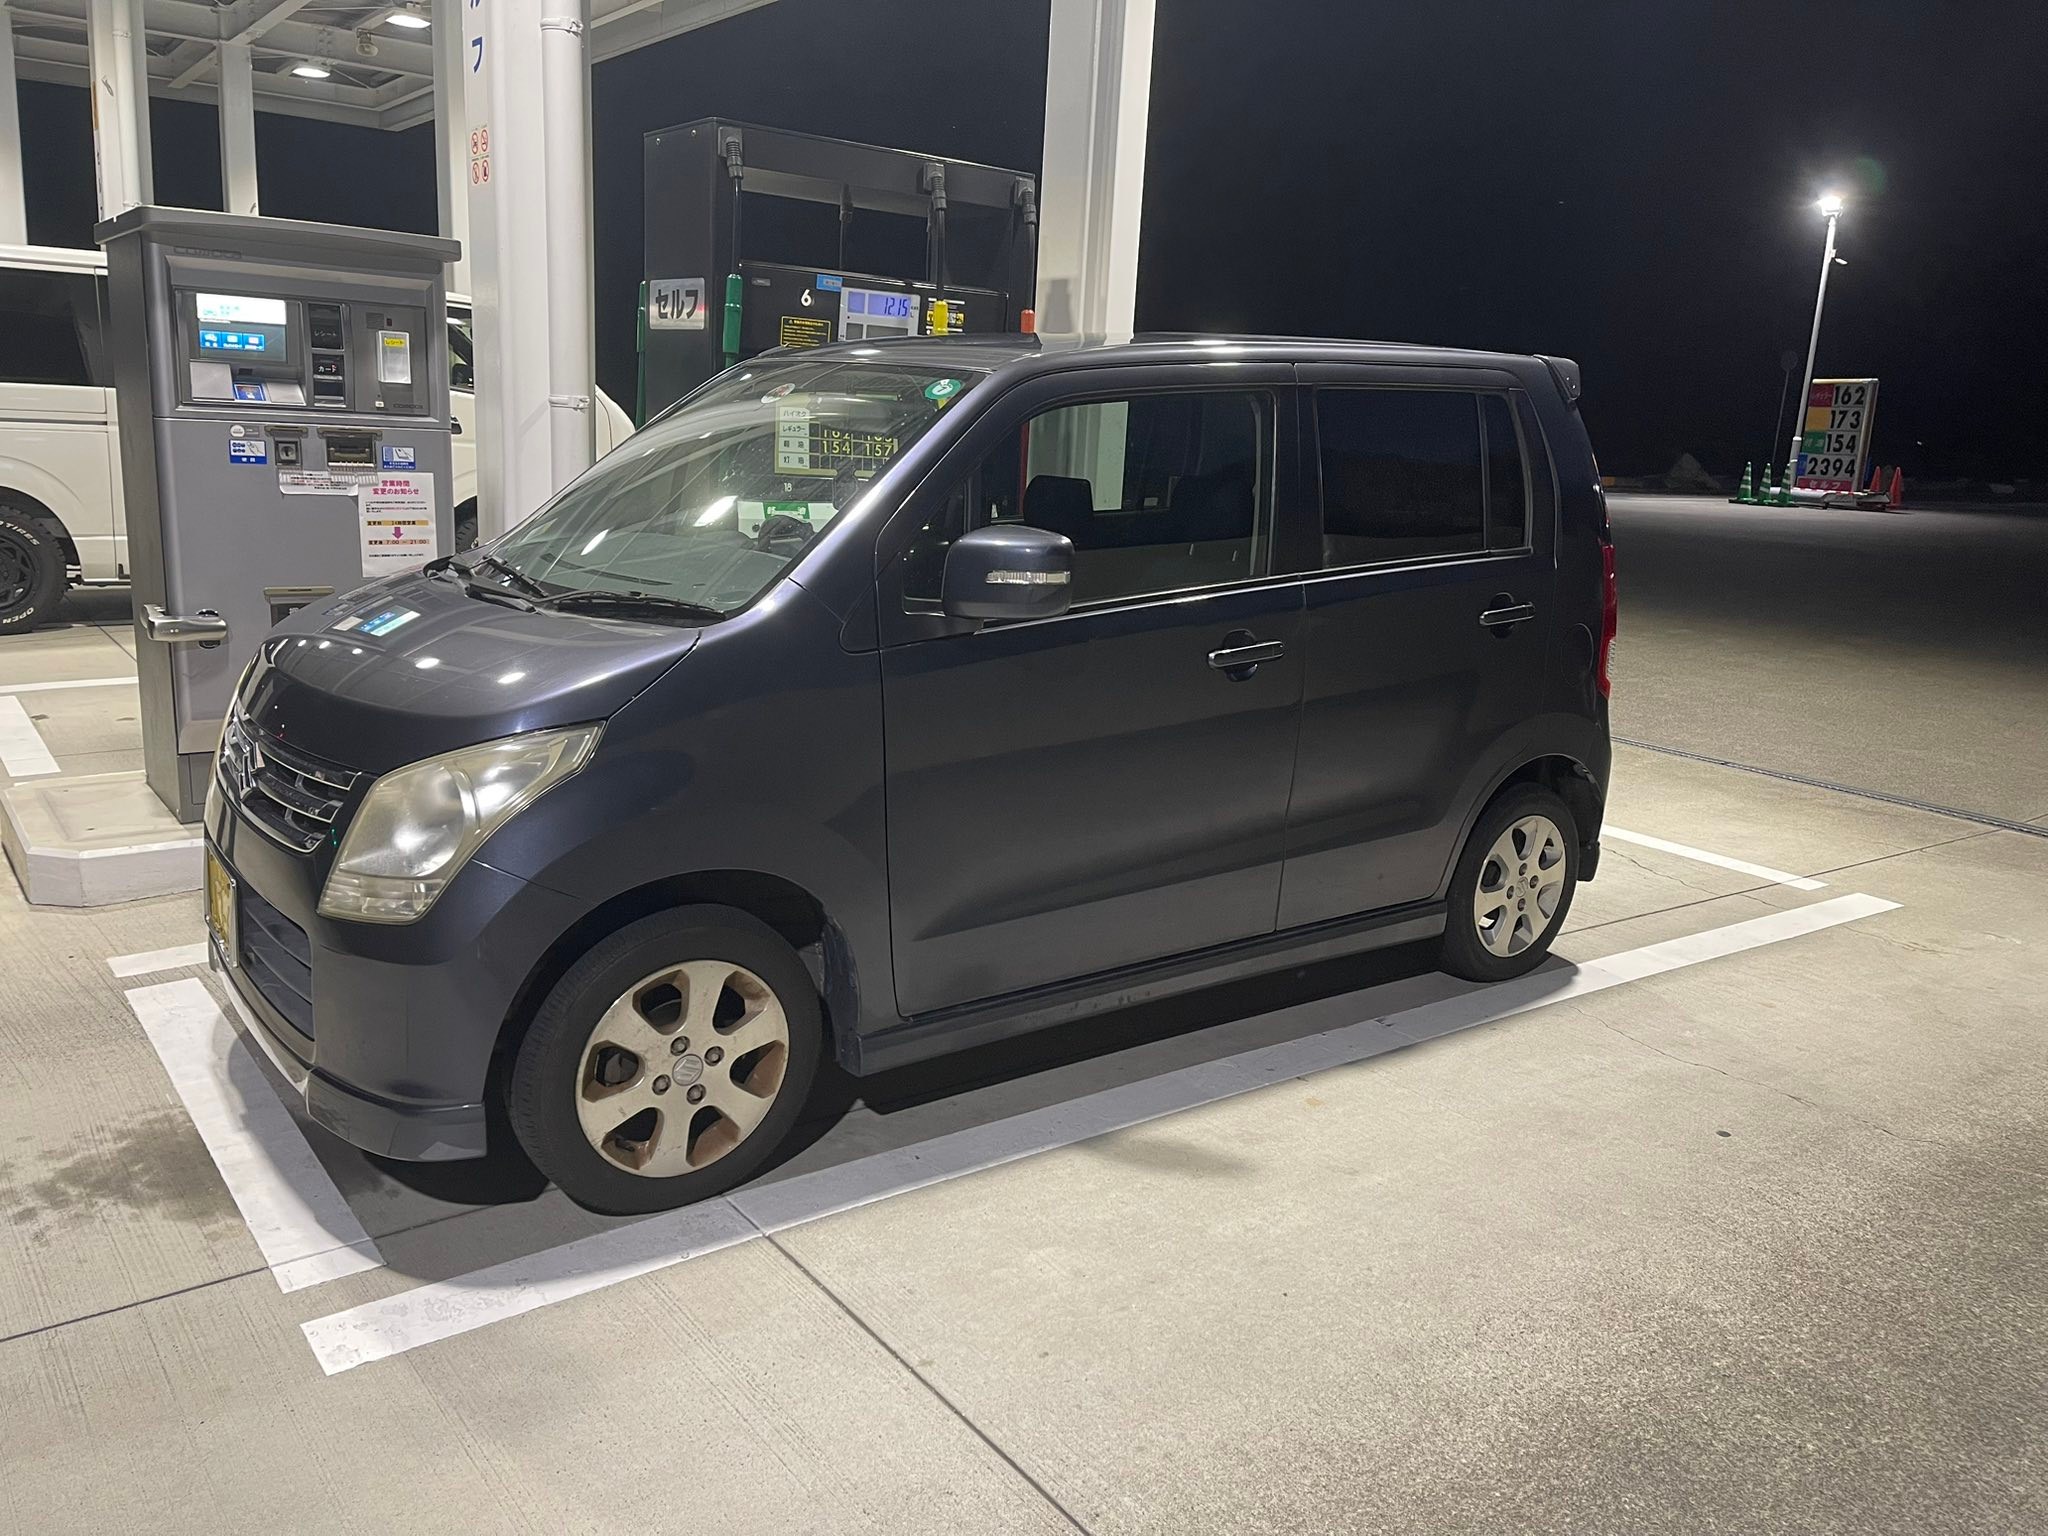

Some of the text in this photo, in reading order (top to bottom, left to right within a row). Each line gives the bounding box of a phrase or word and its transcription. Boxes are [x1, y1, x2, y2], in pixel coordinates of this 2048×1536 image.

[655, 288, 698, 319] セルフ
[801, 289, 812, 307] 6
[318, 364, 337, 373] カード
[1835, 386, 1865, 405] 162
[1830, 410, 1860, 429] 173
[783, 425, 806, 433] レギュラー
[823, 440, 851, 454] 154
[866, 443, 892, 457] 157
[1826, 434, 1856, 453] 154
[1807, 457, 1856, 478] 2394
[1809, 480, 1840, 489] セルフ
[6, 522, 41, 546] TIRES
[2, 607, 34, 624] OPEN
